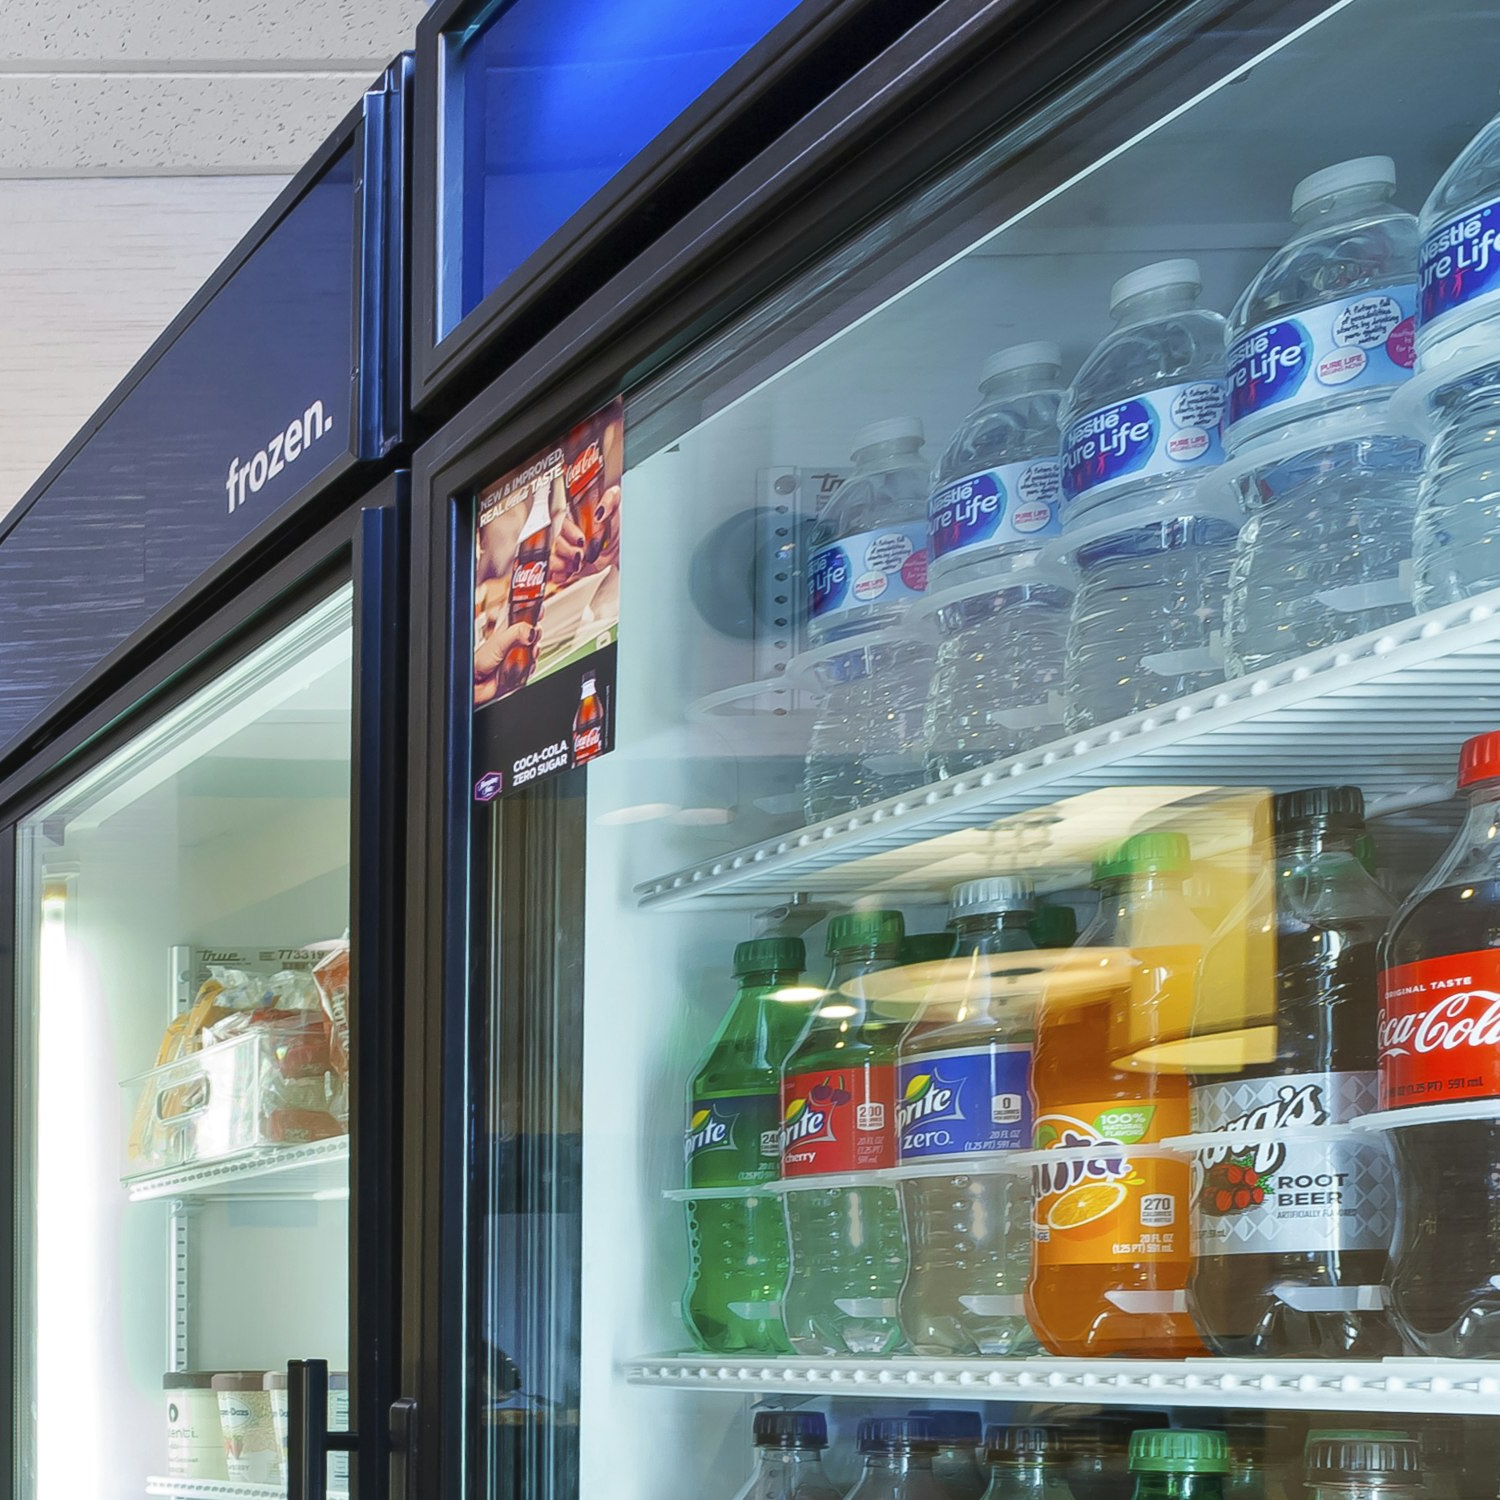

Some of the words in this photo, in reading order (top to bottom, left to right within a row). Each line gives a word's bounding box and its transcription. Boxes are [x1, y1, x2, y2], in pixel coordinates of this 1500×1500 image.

[1250, 342, 1303, 384] Life
[1320, 360, 1342, 374] PURE
[1343, 354, 1363, 368] LIFE
[1100, 420, 1150, 458] Life
[1169, 438, 1190, 450] PURE
[1190, 434, 1207, 446] LIFE
[224, 399, 334, 514] frozen.
[480, 488, 504, 512] NEW
[503, 484, 511, 497] &
[479, 502, 504, 528] REAL
[954, 494, 1000, 527] Life
[1015, 512, 1033, 523] PURE
[1033, 509, 1048, 520] LIFE
[512, 559, 548, 590] Coca-Cola
[815, 565, 846, 595] Life
[513, 740, 567, 773] COCA-COLA
[513, 767, 537, 787] ZERO
[537, 753, 568, 776] SUGAR
[278, 949, 325, 961] 773319
[1384, 984, 1427, 999] ORIGINAL
[1430, 976, 1472, 990] TASTE
[858, 1104, 883, 1118] 200
[896, 1087, 952, 1133] prite
[1001, 1096, 1011, 1109] 0
[1099, 1111, 1146, 1125] 100%
[904, 1129, 950, 1150] zero
[785, 1150, 817, 1167] cherry
[1277, 1173, 1349, 1189] ROOT
[1143, 1197, 1171, 1211] 270
[1277, 1192, 1343, 1207] BEER
[1139, 1234, 1152, 1244] 20
[1162, 1233, 1174, 1243] OZ
[1112, 1244, 1130, 1255] (1.25
[1131, 1243, 1145, 1255] PT)
[1146, 1243, 1159, 1253] 591
